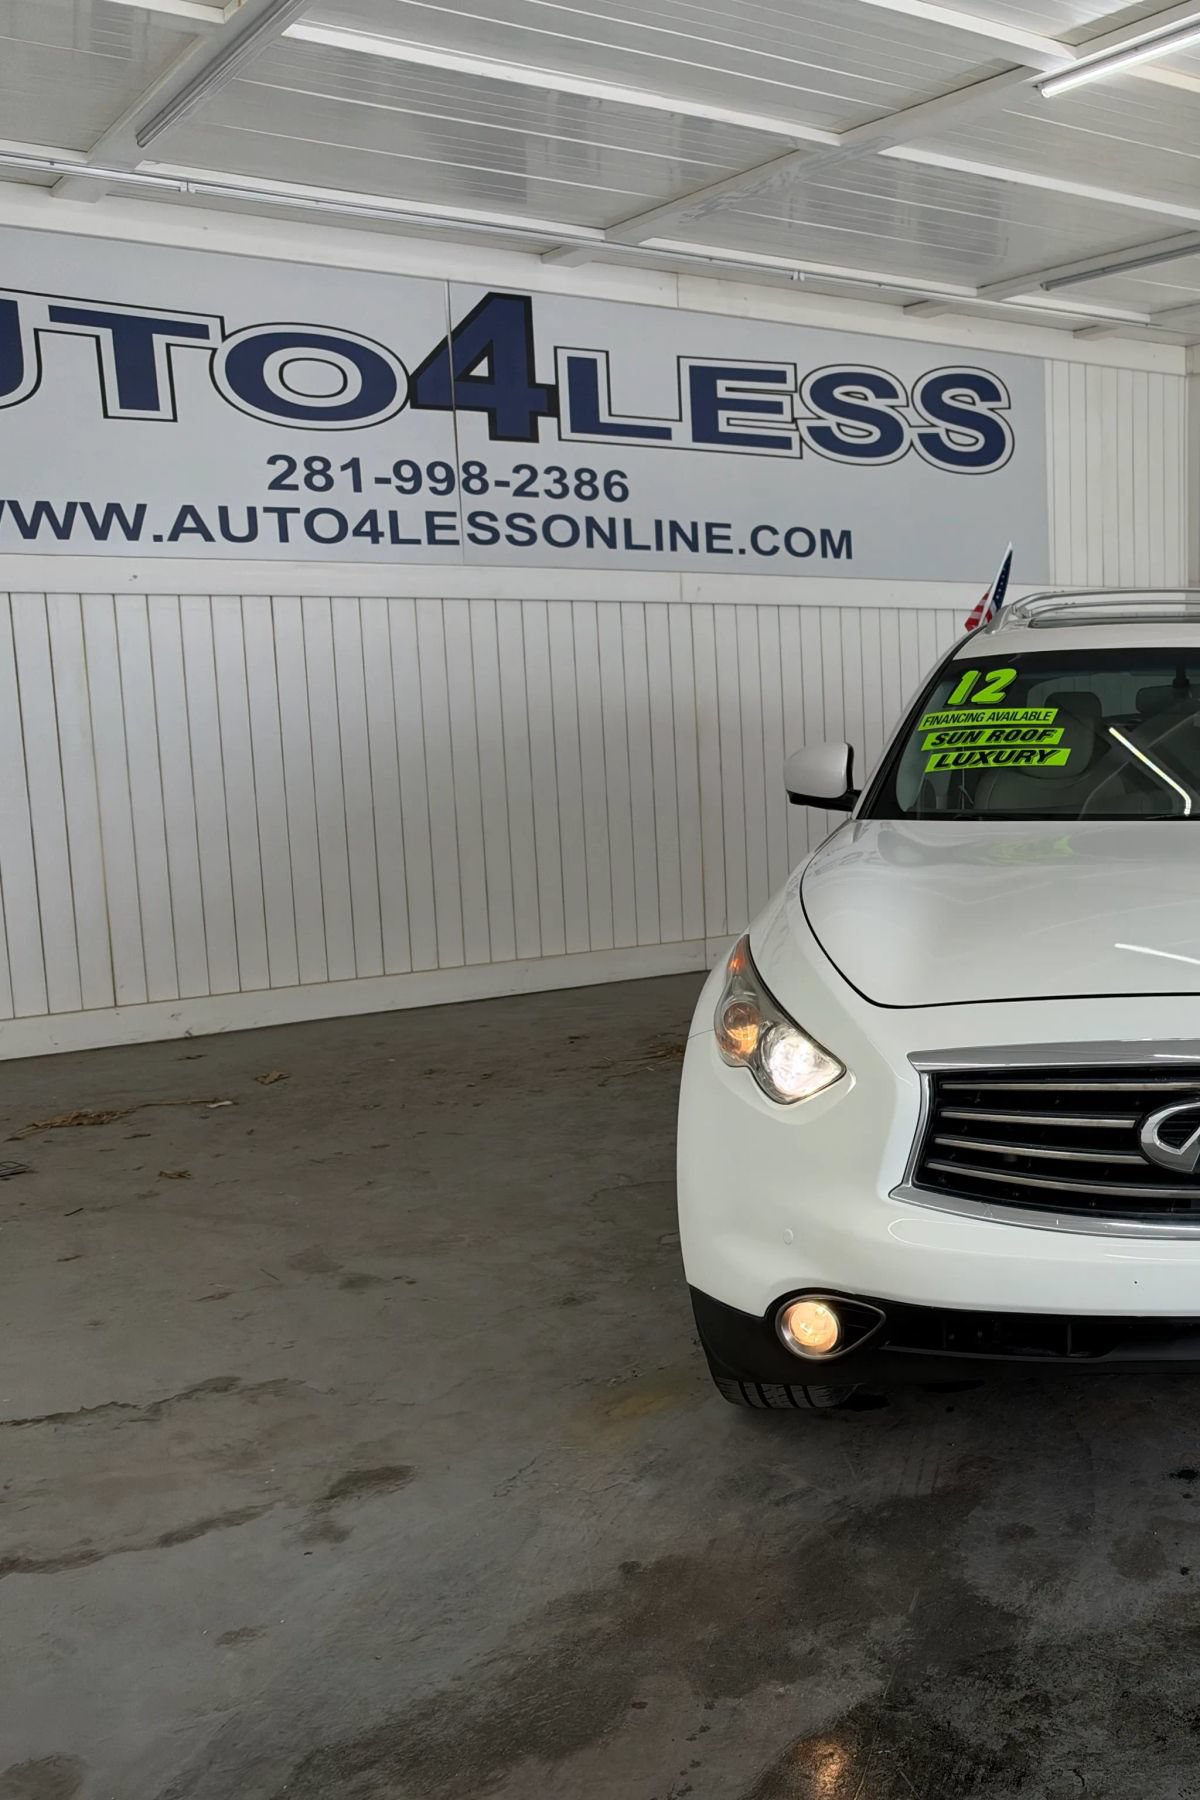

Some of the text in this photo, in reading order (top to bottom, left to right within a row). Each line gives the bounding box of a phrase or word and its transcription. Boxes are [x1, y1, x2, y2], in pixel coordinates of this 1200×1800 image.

[266, 454, 630, 503] 281-998-2386
[0, 499, 854, 560] WW.AUTO4LESSONLINE.COM
[946, 668, 1018, 706] 12
[923, 711, 1053, 727] FINANCING AVAILABLE
[931, 729, 1058, 746] SUN ROOF
[934, 749, 1058, 769] LUXURY
